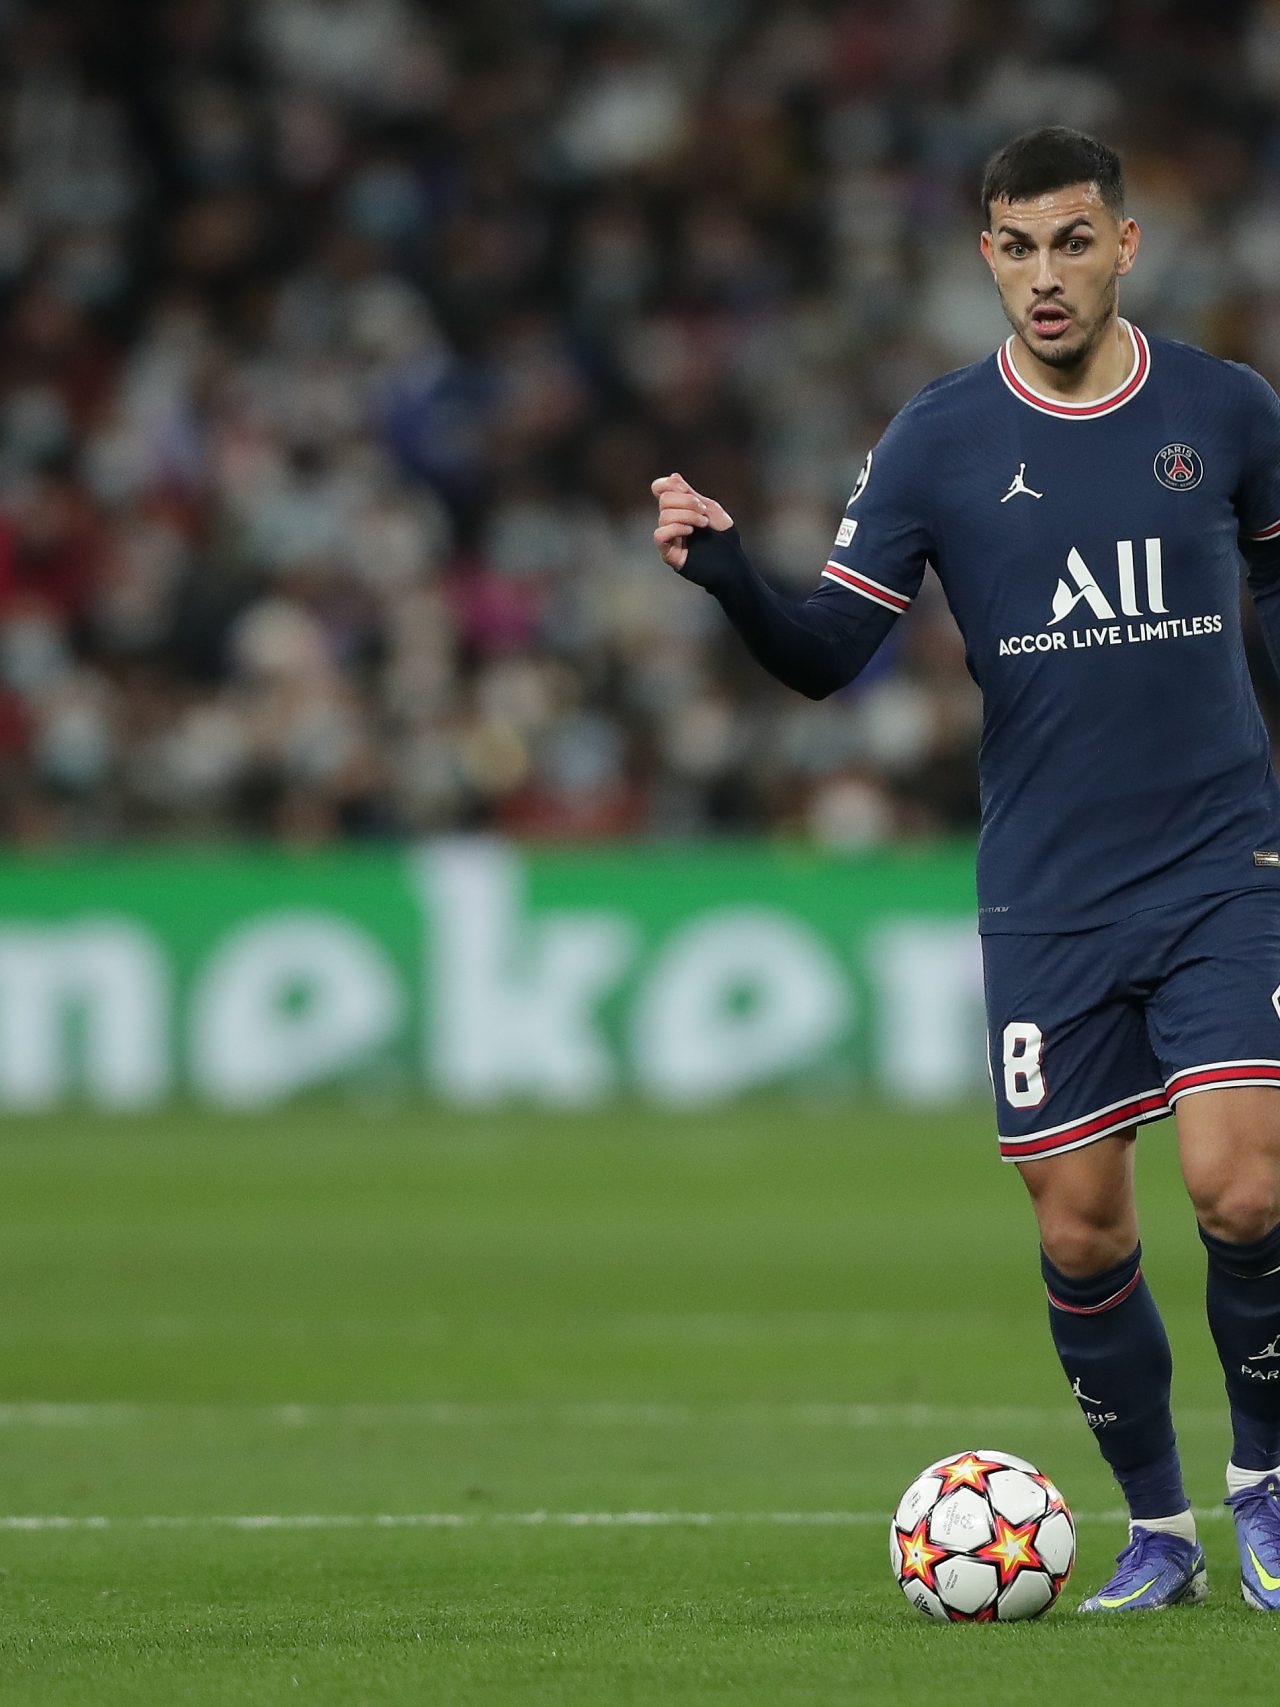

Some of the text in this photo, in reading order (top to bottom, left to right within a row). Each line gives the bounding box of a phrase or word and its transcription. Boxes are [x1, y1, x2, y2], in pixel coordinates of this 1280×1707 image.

[1160, 446, 1193, 460] PARIS
[999, 614, 1222, 656] ACCOR LIVE LIMITLESS
[1003, 1022, 1046, 1109] 8
[1085, 1411, 1118, 1423] RIS
